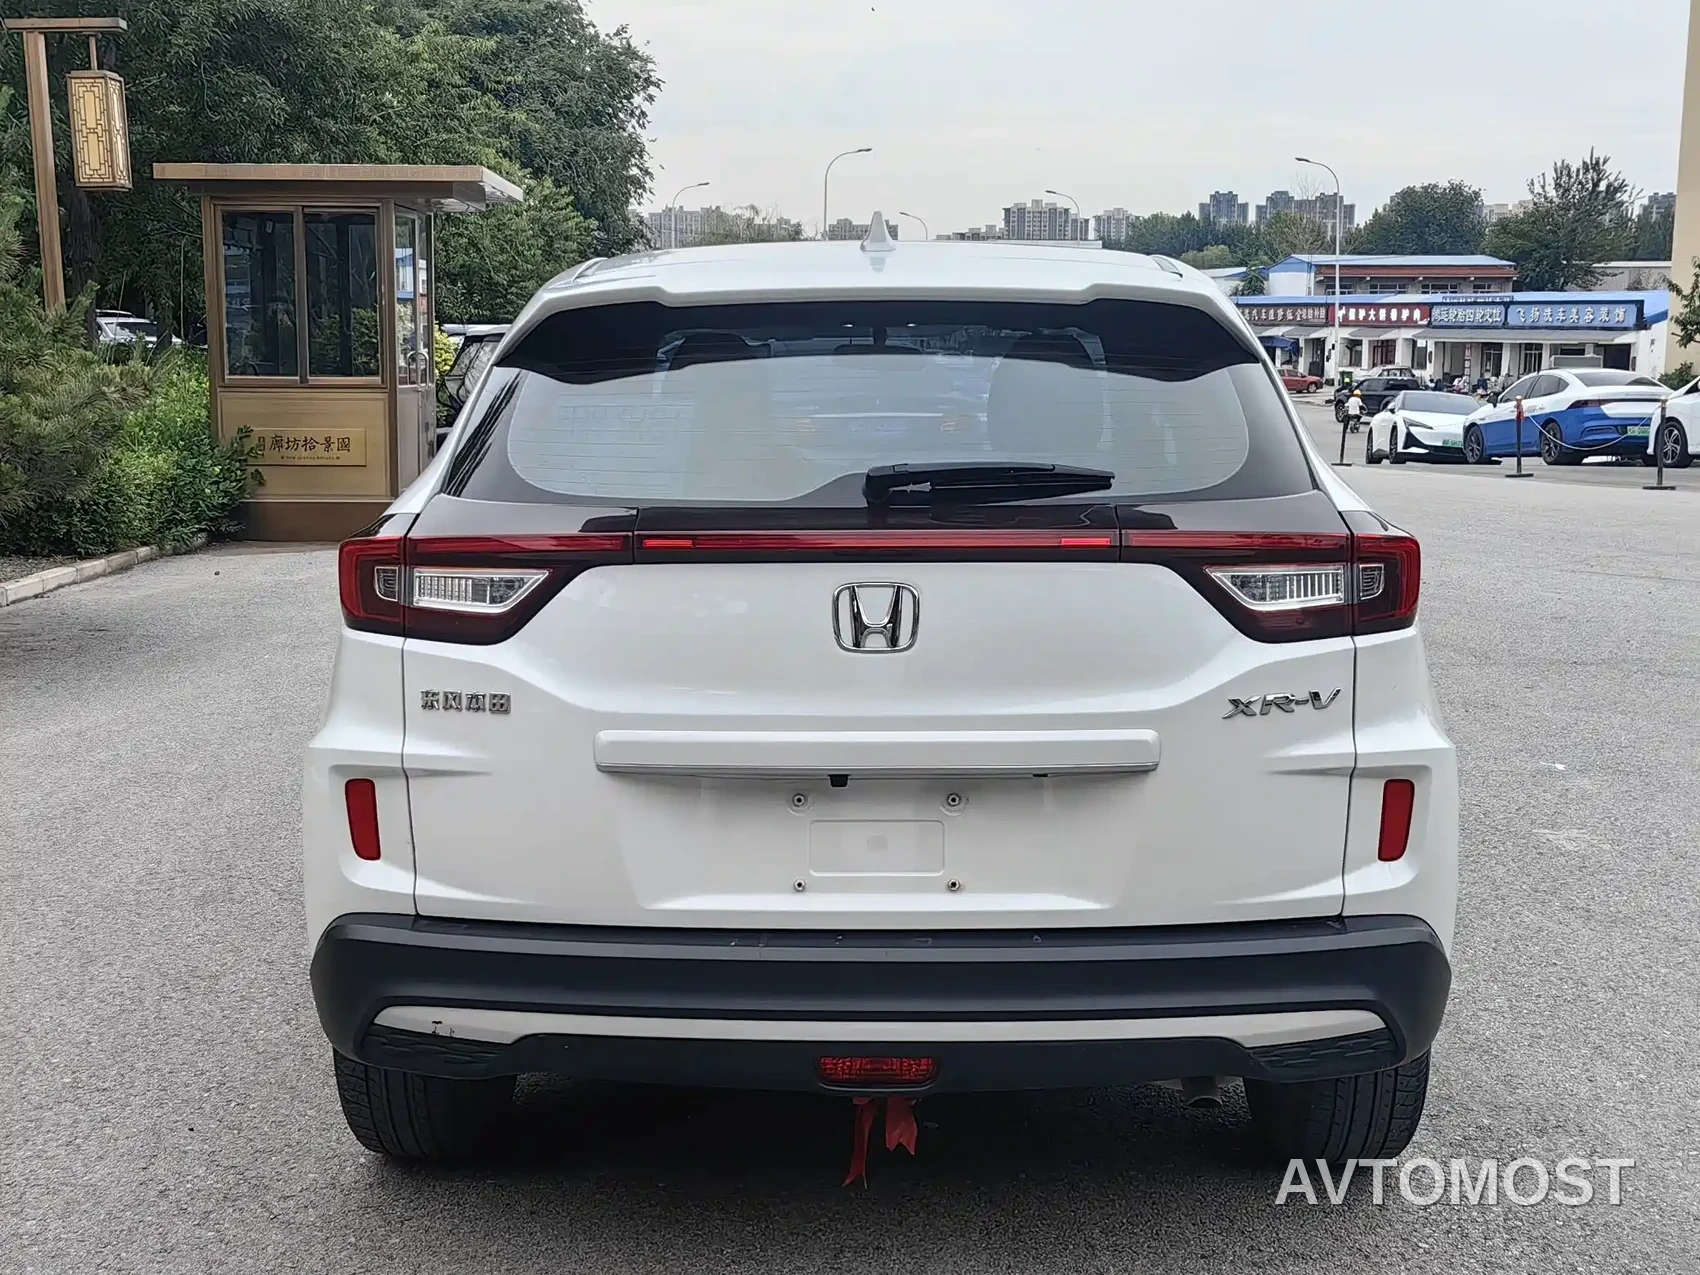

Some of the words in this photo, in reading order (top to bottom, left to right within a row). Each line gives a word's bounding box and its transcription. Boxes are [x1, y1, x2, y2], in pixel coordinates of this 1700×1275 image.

[1516, 306, 1627, 323] 飞扬洗车美容装饰
[420, 689, 511, 714] 东风本田
[1222, 686, 1342, 719] XR-V
